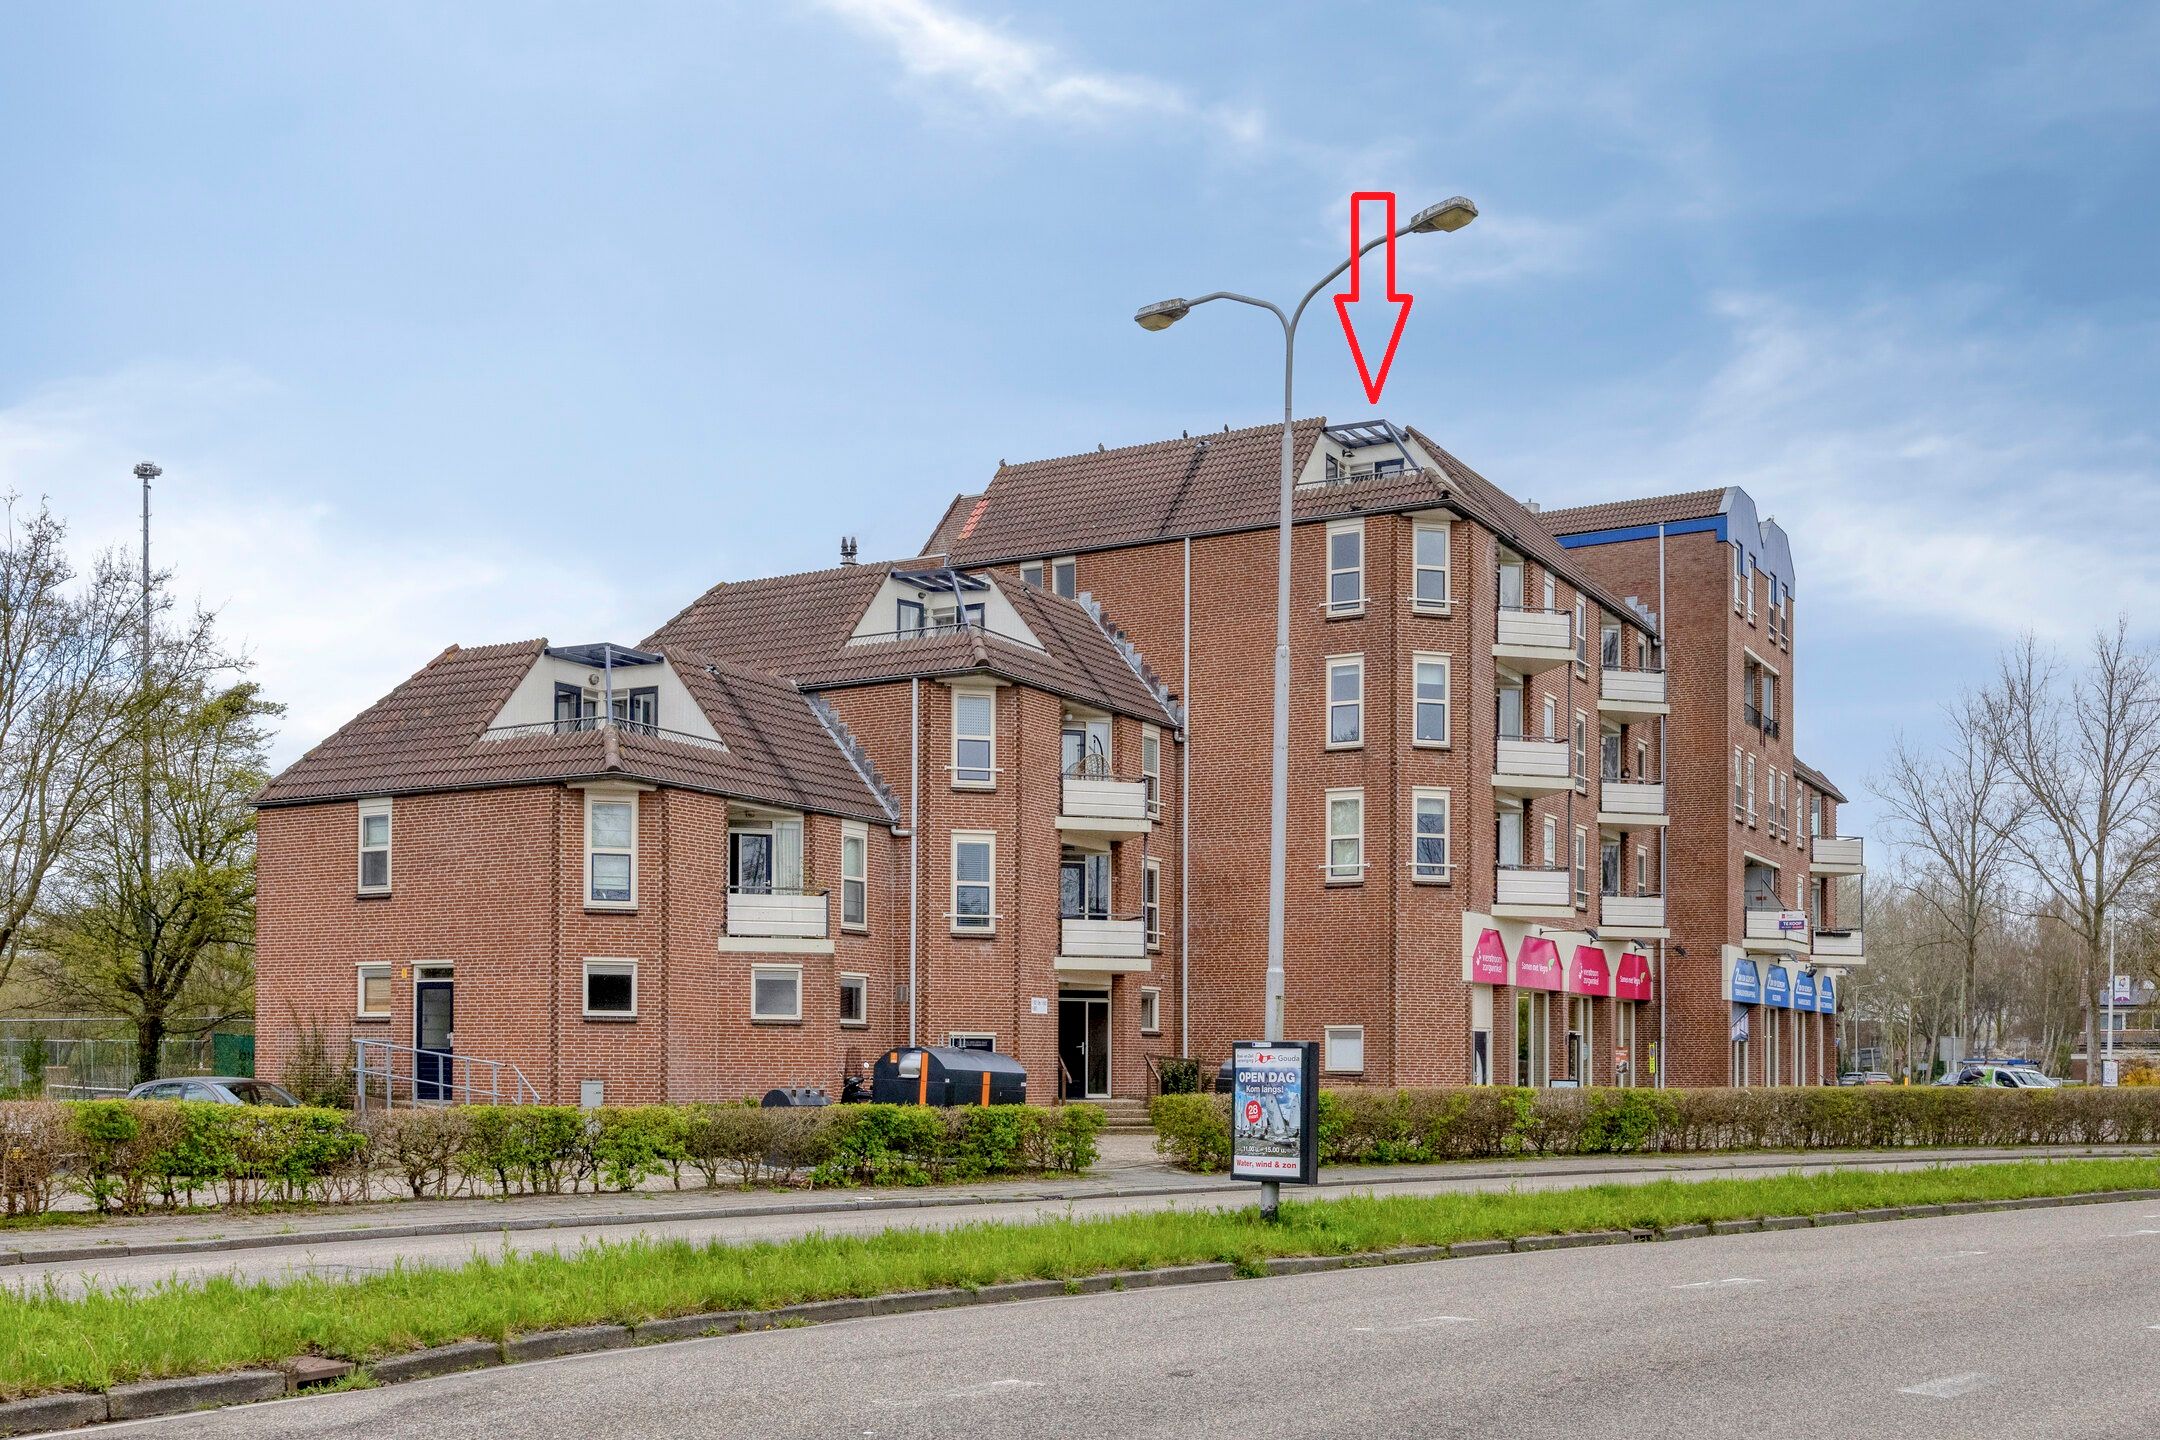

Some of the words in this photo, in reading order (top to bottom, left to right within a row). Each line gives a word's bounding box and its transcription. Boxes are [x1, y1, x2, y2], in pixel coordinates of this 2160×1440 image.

[1239, 1071, 1265, 1083] OPEN
[1268, 1071, 1296, 1083] DAG
[1246, 1085, 1260, 1093] Kom
[1262, 1085, 1284, 1094] langs!
[1236, 1159, 1254, 1168] Water,
